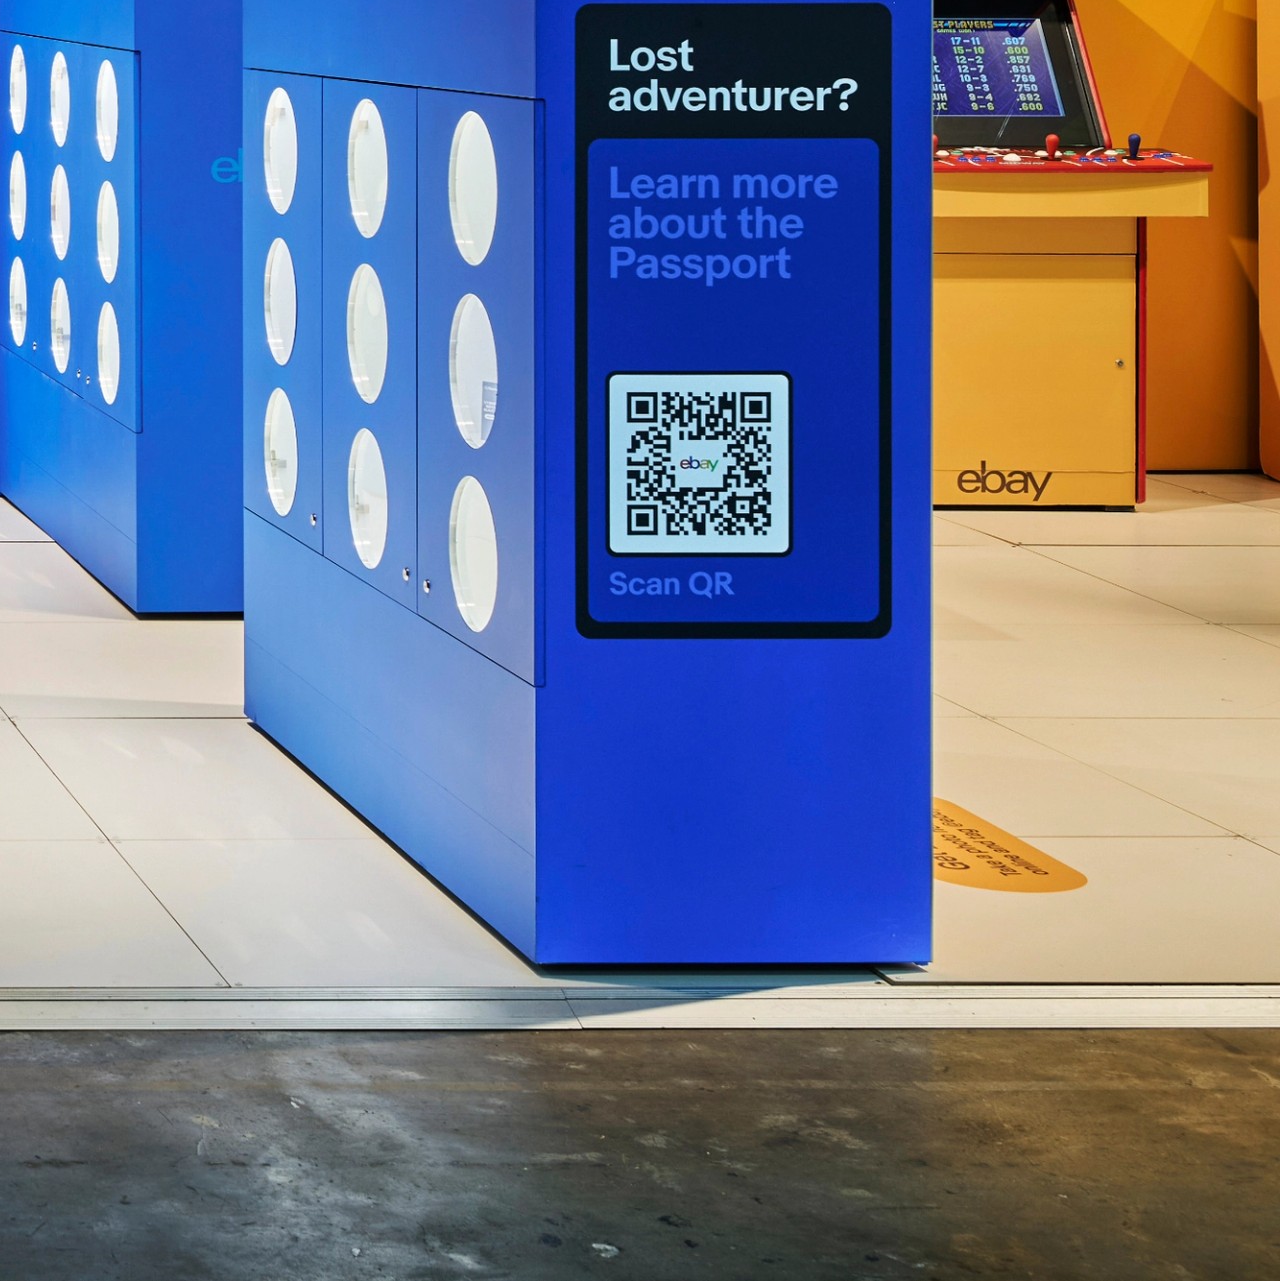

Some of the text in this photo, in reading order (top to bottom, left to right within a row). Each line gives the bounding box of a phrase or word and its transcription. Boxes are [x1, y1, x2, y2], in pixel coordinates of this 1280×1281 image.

[610, 38, 694, 71] Lost
[608, 77, 858, 112] adventurer?
[610, 166, 838, 199] Learn more
[608, 206, 804, 239] about the
[610, 246, 792, 287] Passport
[680, 456, 719, 472] ebay
[957, 460, 1053, 502] ebay
[609, 571, 735, 599] Scan QR
[941, 833, 989, 854] photo
[976, 840, 1010, 854] and
[986, 860, 1022, 877] Take
[1004, 853, 1049, 876] online
